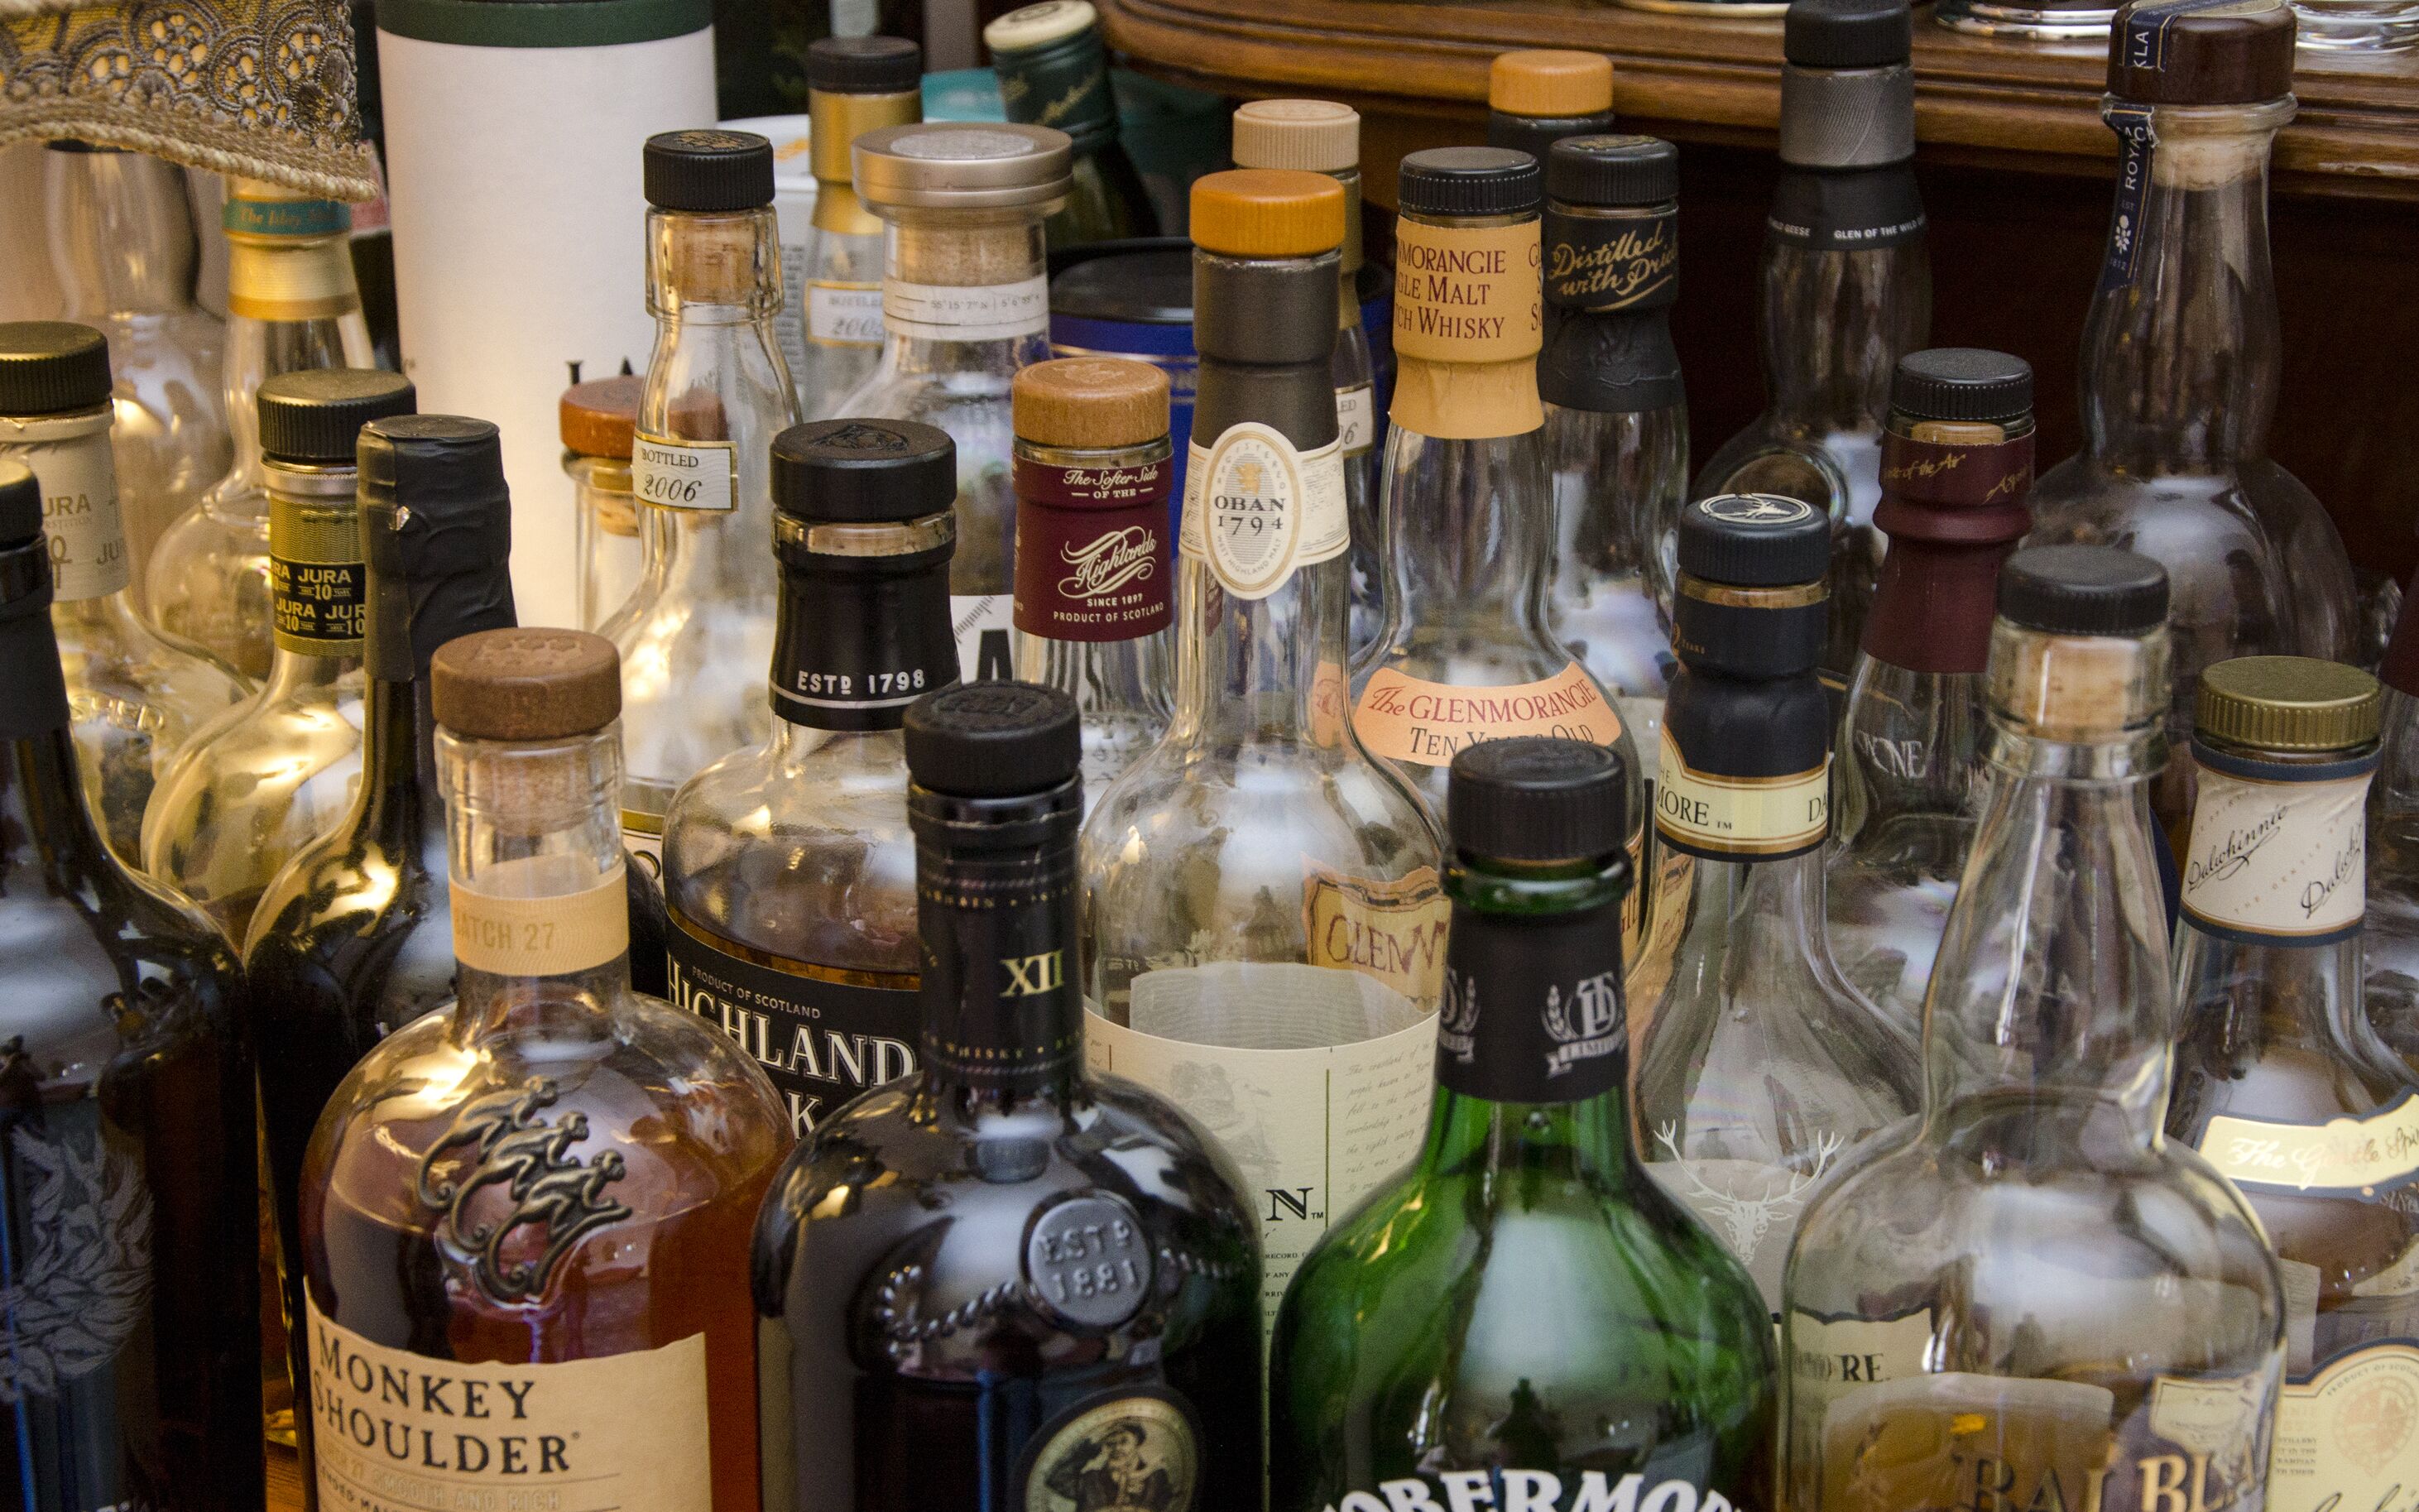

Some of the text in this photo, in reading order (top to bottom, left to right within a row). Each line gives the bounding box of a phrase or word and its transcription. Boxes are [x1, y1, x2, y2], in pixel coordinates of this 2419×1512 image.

[1833, 219, 1917, 240] GLEN OF THE WILD
[1548, 220, 1664, 280] Distilled
[1559, 264, 1625, 296] with
[1418, 305, 1506, 340] WHISKY
[1337, 399, 1356, 413] ED
[641, 448, 699, 468] BOTTLED
[643, 473, 703, 502] 2006
[1063, 464, 1159, 490] The Softer Side
[1093, 487, 1136, 499] OF THE
[1213, 495, 1286, 511] OBAN
[1217, 516, 1284, 536] 1794
[1074, 527, 1157, 589] Highlands
[1228, 559, 1269, 575] HIGHLAND
[297, 568, 352, 584] JURA
[314, 583, 332, 601] 10
[1086, 593, 1144, 607] SINCE 1897
[276, 597, 317, 619] JURA
[1053, 602, 1164, 622] PRODUCT OF SCOTLAND
[286, 614, 300, 632] 10
[346, 617, 365, 636] 10
[796, 668, 926, 695] ESTD 1798
[1367, 685, 1406, 716] The
[1409, 679, 1597, 724] GLENMORANGIE
[1410, 727, 1459, 757] TEN
[2186, 804, 2290, 895] Dalwhinnie
[525, 922, 555, 951] 27
[999, 948, 1065, 998] XII
[692, 966, 822, 1020] PRODUCT OF SCOTLAND
[2228, 1137, 2287, 1169] The
[1265, 1187, 1324, 1222] N TM
[1051, 1257, 1136, 1302] 1881
[318, 1324, 535, 1419] MONKEY
[2326, 1368, 2369, 1397] PRODUCT
[313, 1369, 570, 1475] SHOULDER
[456, 1491, 497, 1510] AND
[507, 1492, 562, 1510] RICH
[1324, 1469, 1737, 1512] OBERMO
